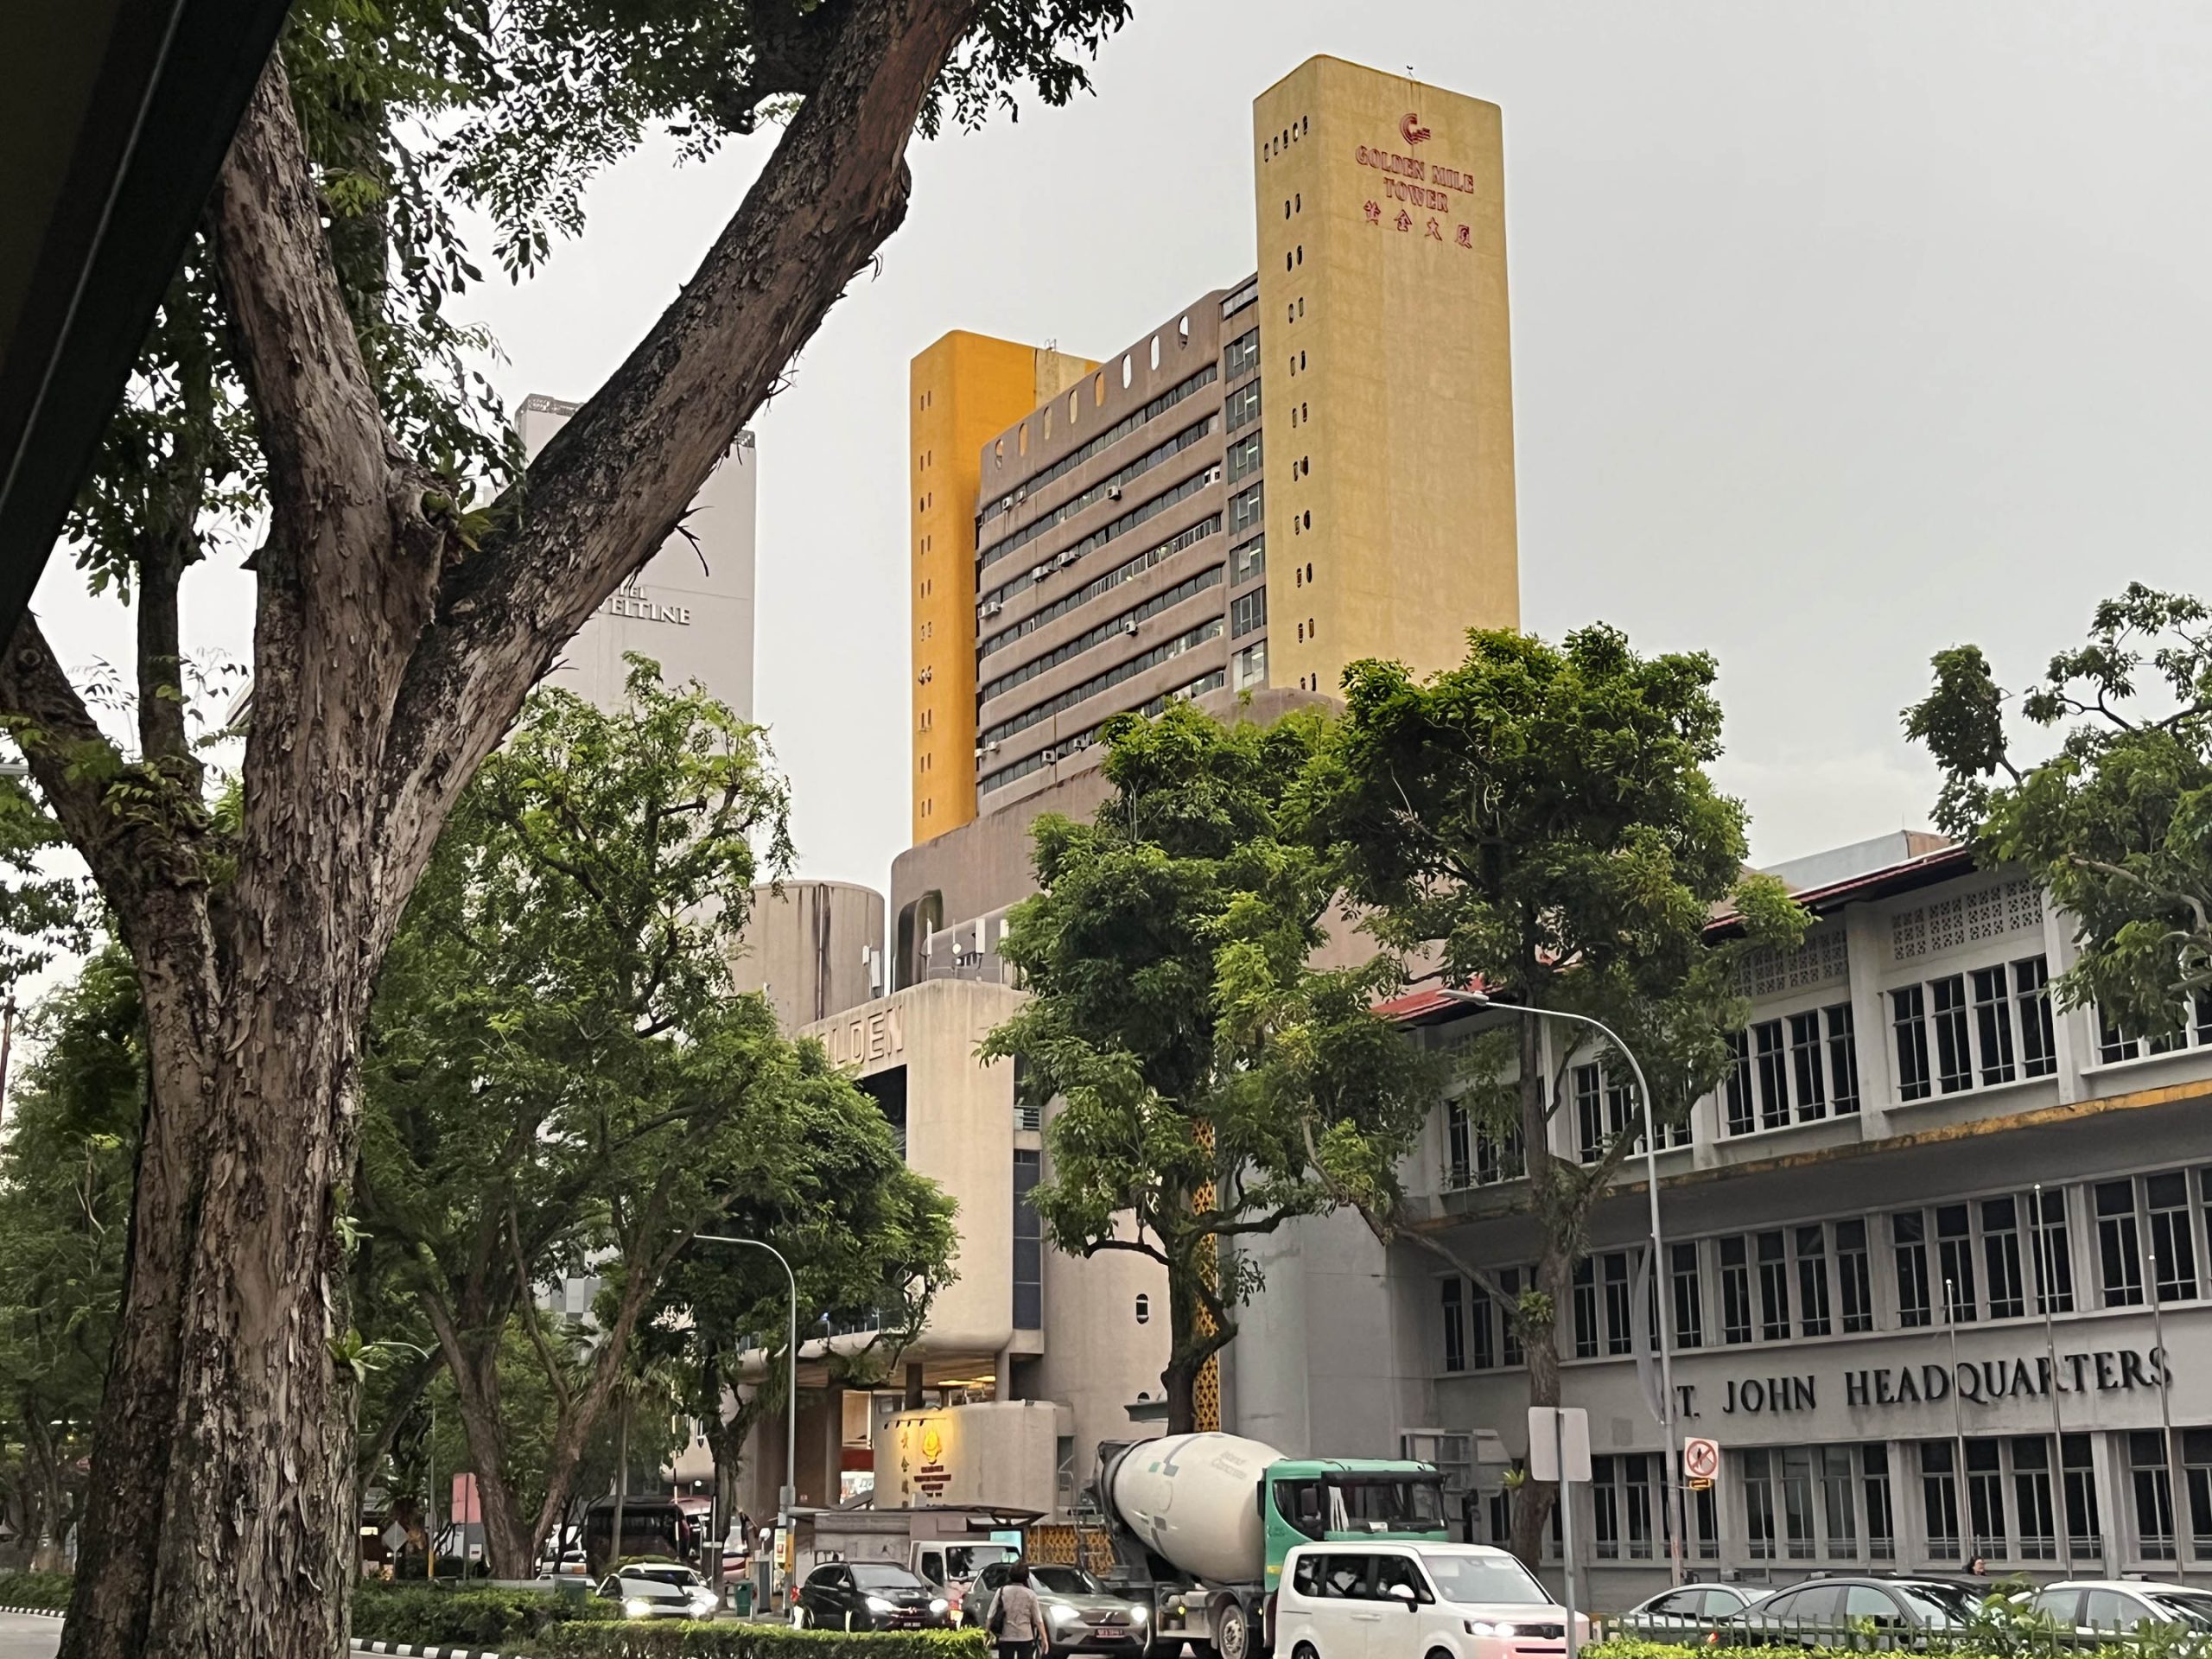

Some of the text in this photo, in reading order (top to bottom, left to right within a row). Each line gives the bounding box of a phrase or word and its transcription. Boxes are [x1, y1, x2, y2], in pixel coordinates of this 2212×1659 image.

[1355, 145, 1474, 194] GOLDEN MILE
[1383, 177, 1448, 213] TOWER
[819, 1005, 904, 1072] LDEN
[1722, 1375, 1817, 1414] JOHN
[1845, 1346, 2172, 1406] HEADQUARTERS
